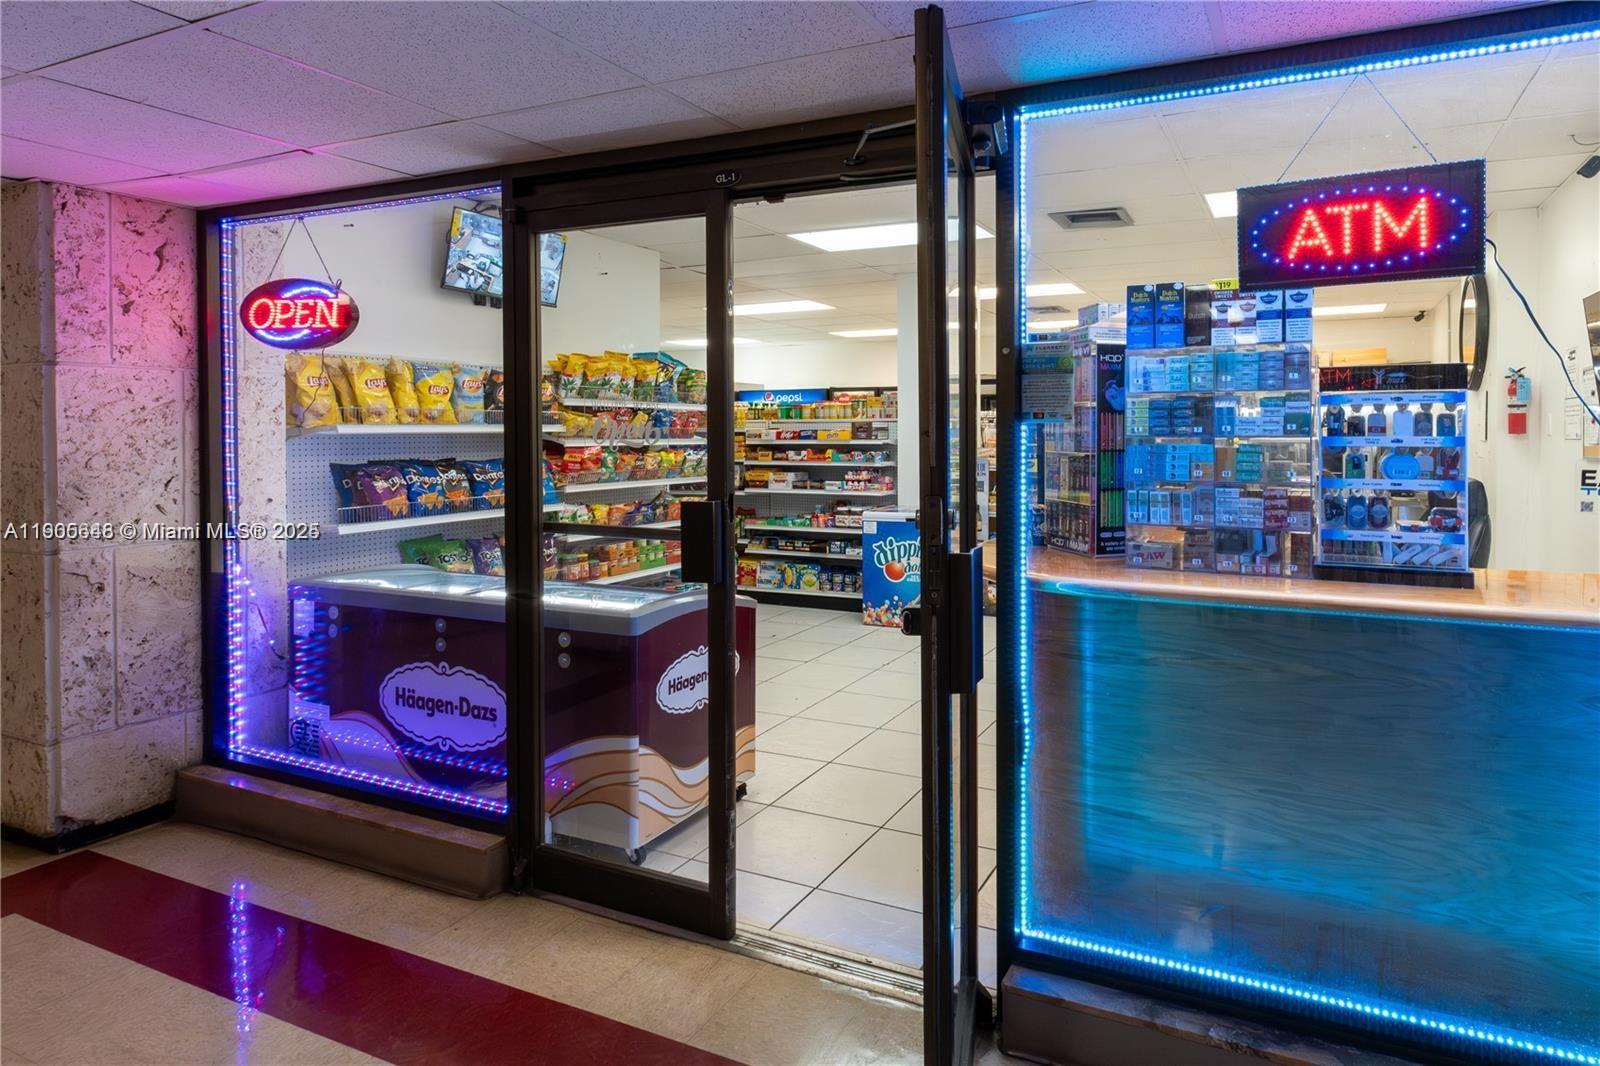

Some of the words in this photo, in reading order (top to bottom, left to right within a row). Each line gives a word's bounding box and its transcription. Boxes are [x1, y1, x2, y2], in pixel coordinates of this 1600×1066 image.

[1287, 195, 1429, 260] ATM
[249, 298, 339, 329] OPEN
[776, 392, 803, 403] pepsi
[395, 686, 498, 722] Häagen-Dazs
